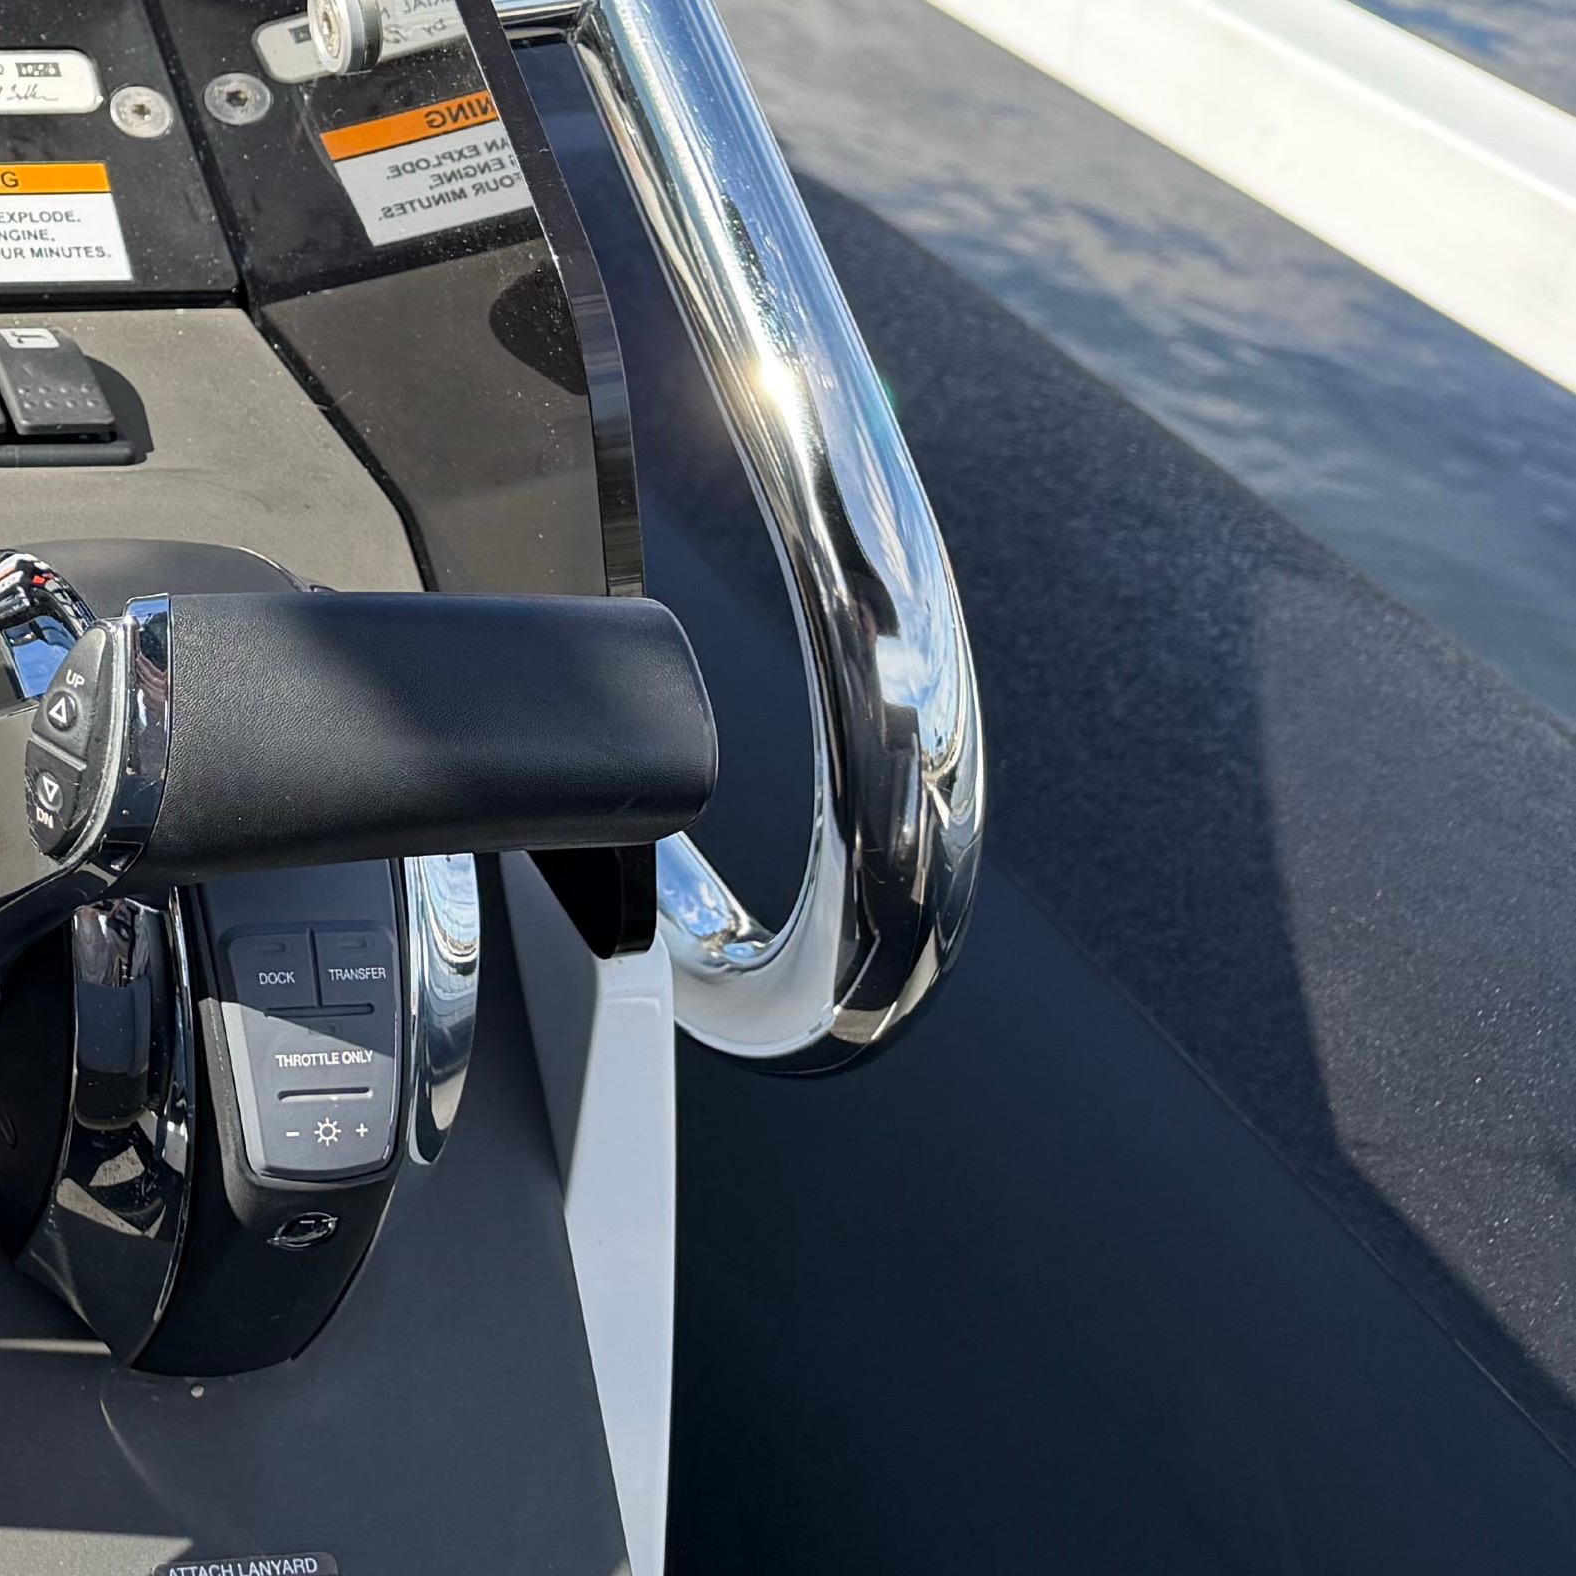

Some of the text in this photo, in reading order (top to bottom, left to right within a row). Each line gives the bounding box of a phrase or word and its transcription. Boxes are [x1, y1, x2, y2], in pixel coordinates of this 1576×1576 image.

[30, 245, 112, 259] MINUTES.
[65, 669, 85, 688] UP
[36, 807, 54, 829] DN
[259, 972, 295, 985] DOCK
[328, 967, 387, 981] TRANSFER
[275, 1050, 373, 1067] THROTTLE ONLY
[238, 1557, 318, 1576] LANYARD
